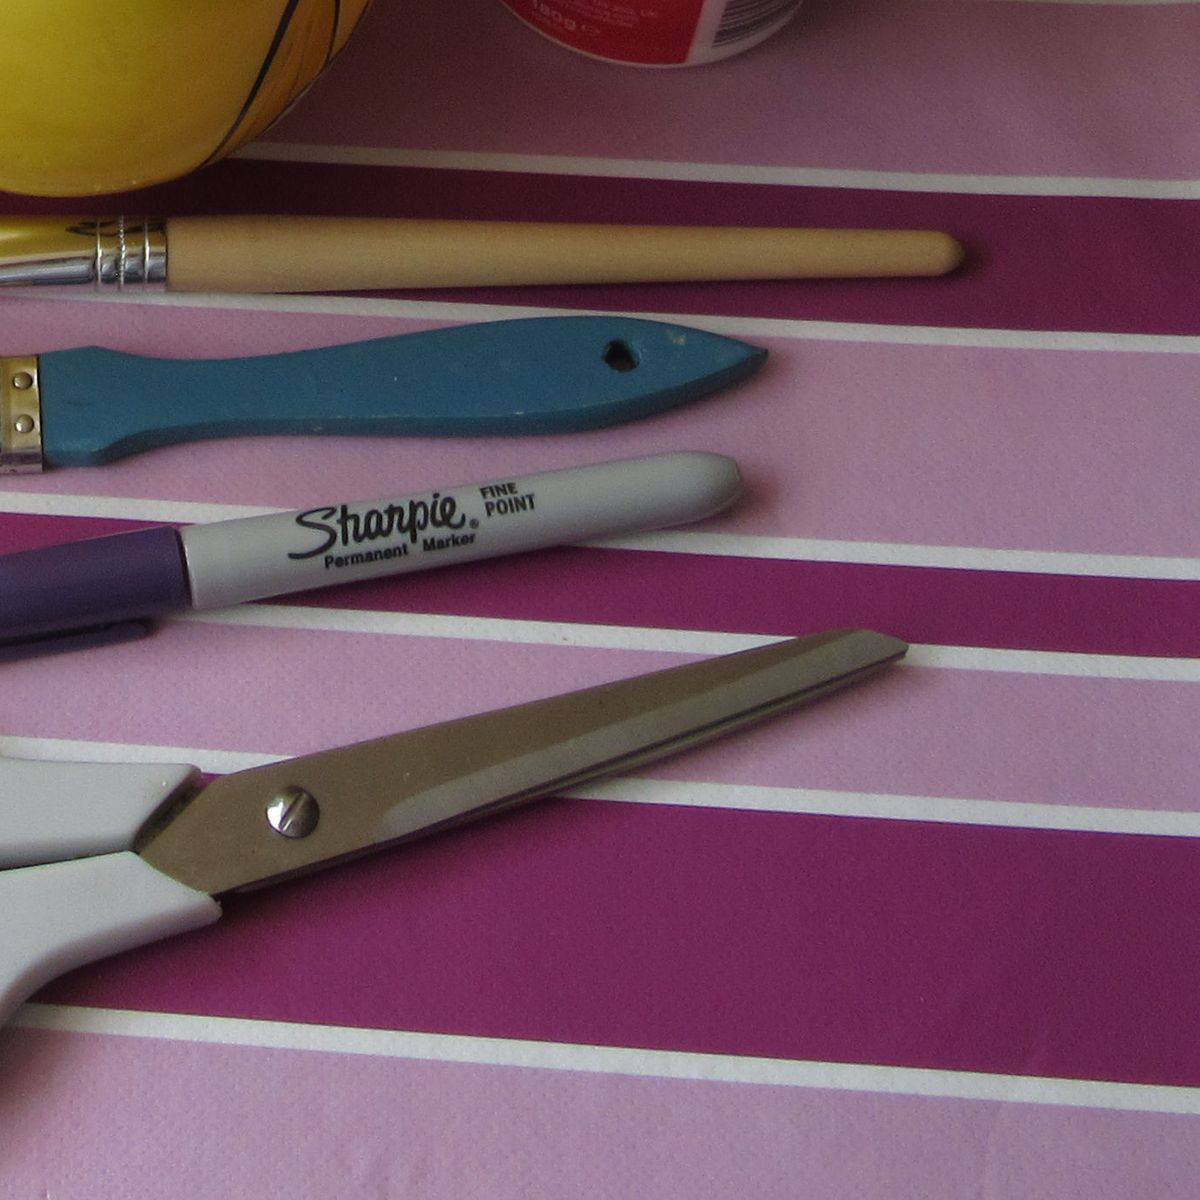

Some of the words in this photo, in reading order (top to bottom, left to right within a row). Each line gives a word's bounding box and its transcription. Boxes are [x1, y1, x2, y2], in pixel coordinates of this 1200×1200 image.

[480, 482, 518, 500] FINE
[485, 494, 536, 517] POINT
[288, 492, 466, 561] Sharpie
[325, 543, 408, 569] Permanent
[423, 532, 476, 553] Marker
